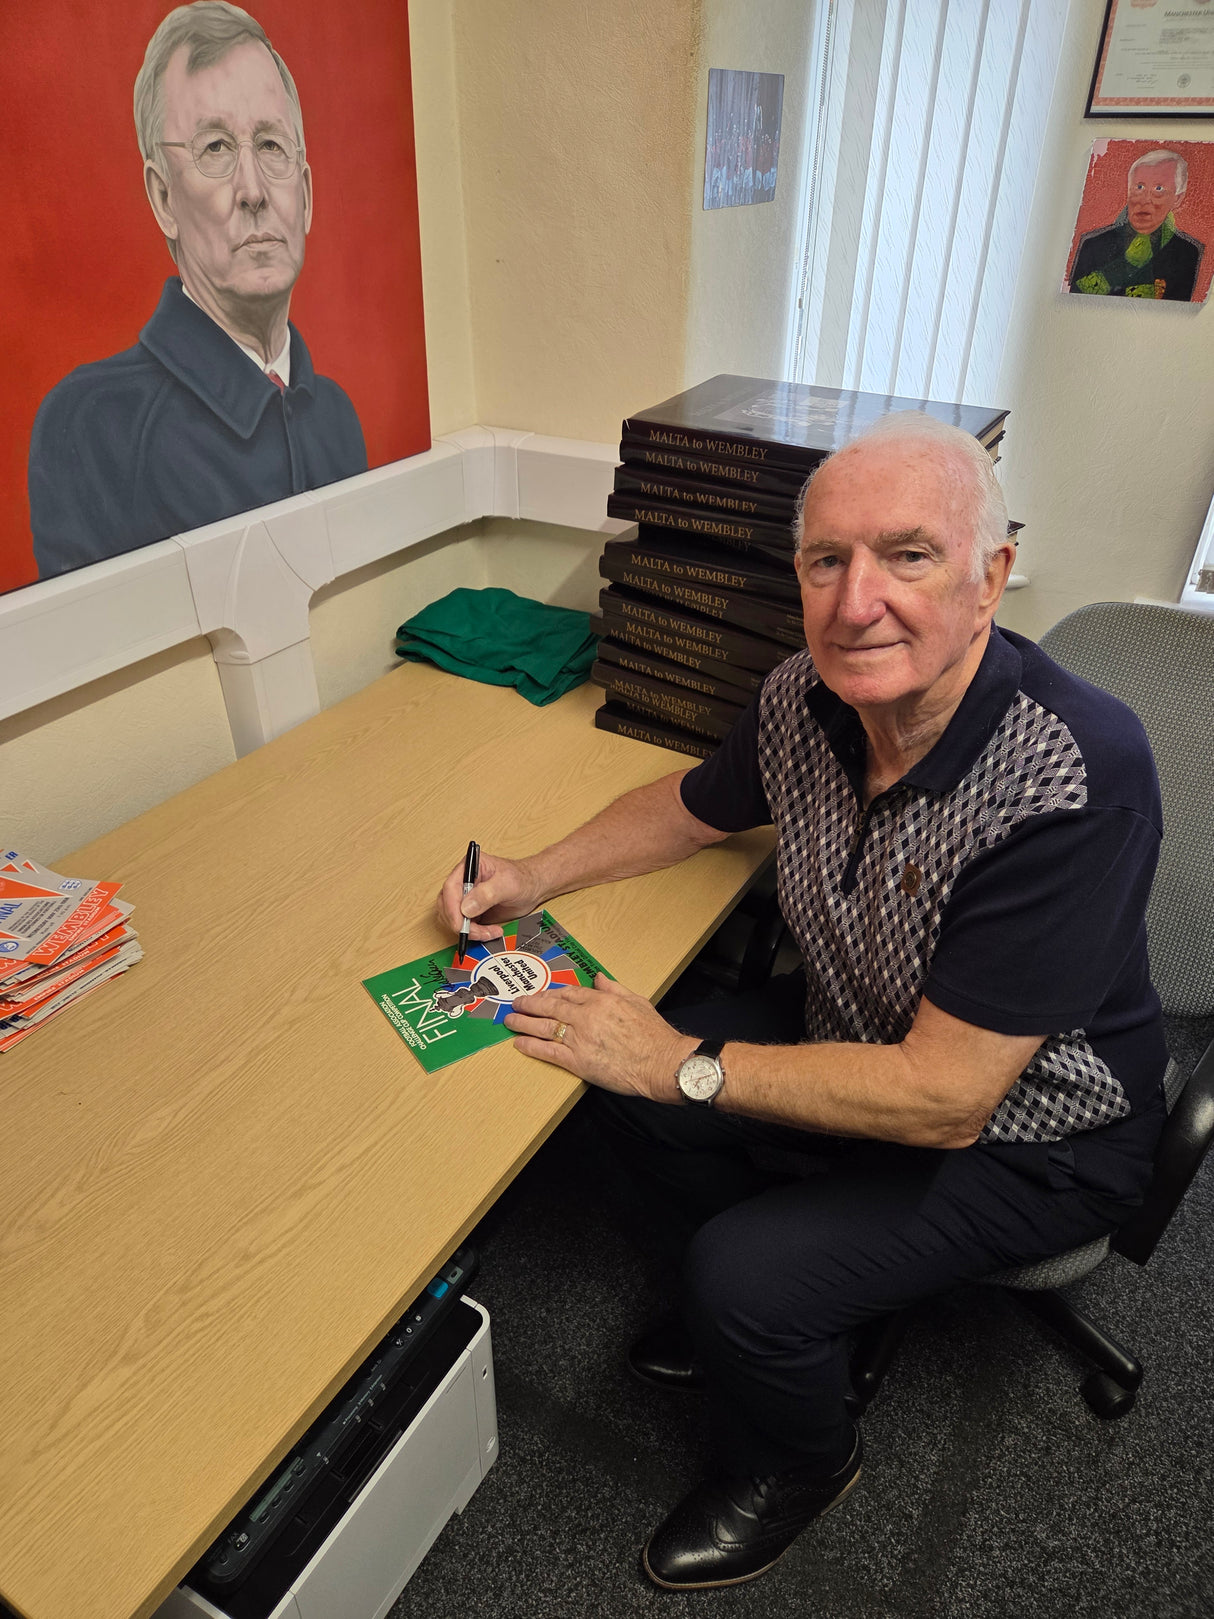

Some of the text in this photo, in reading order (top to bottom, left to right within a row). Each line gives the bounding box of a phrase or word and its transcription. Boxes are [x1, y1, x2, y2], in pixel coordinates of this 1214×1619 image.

[650, 430, 769, 461] MALTA to WEMBLEY
[645, 452, 760, 483] MALTA to WEMBLEY
[640, 483, 758, 513] MALTA to WEMBLEY
[635, 509, 754, 539] MALTA to WEMBLEY
[631, 554, 747, 588] MALTA to WEMBLEY
[623, 572, 659, 591] MALTA
[662, 584, 671, 593] to
[673, 585, 729, 609] WEMBLEY
[622, 603, 722, 644] MALTA to WEMBLEY
[611, 628, 701, 669] MALTA to WEMBLEY
[626, 622, 729, 660] MALTA to WEMBLEY
[619, 657, 716, 695] MALTA to WEMBLEY
[615, 680, 648, 696] MALTA
[660, 693, 712, 716] WEMBLEY
[652, 699, 698, 721] WEMBLEY
[618, 724, 715, 758] MALTA to WEMBLEY
[32, 888, 109, 956] WEMBLEY
[537, 919, 570, 951] STADIUM
[488, 965, 520, 995] Liverpool
[500, 957, 536, 991] Manchester
[514, 959, 538, 980] United
[566, 951, 597, 981] EMBLEY
[380, 1001, 417, 1047] FOOTBALL ASSOCIATION
[381, 994, 427, 1050] CHALLENGE CUP COMPETITION
[391, 978, 457, 1044] FINAL
